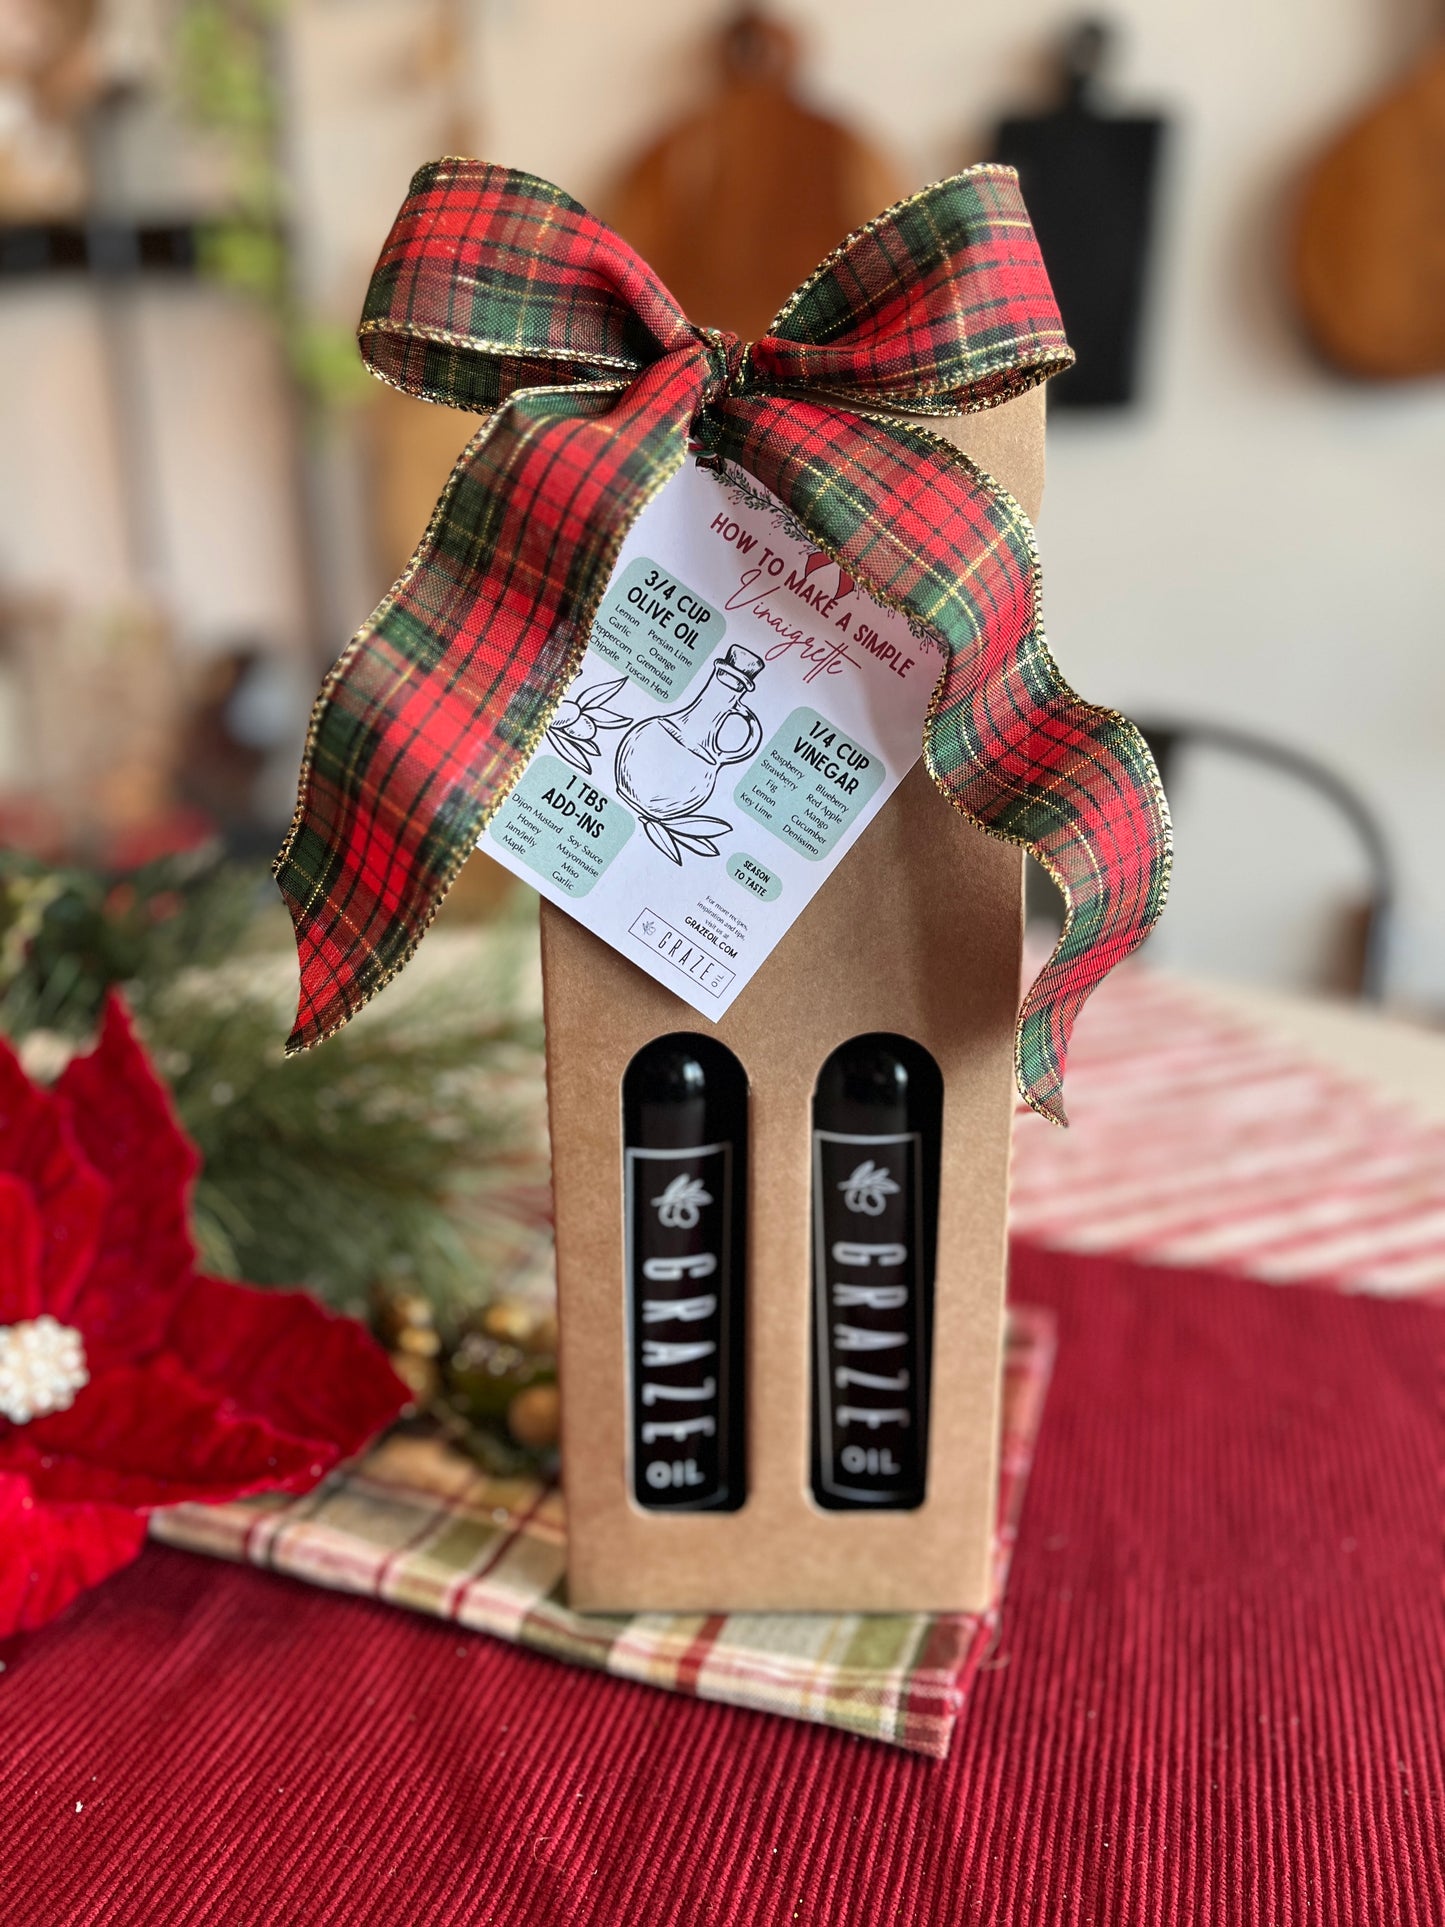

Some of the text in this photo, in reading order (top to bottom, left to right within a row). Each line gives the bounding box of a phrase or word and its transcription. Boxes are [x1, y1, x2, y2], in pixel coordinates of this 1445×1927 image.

[645, 571, 710, 624] 3/4 CUP
[710, 513, 915, 678] HOW TO MAKE A SIMPLE
[609, 616, 631, 637] Garlic
[615, 604, 640, 627] Lemon
[628, 587, 698, 650] OLIVE OIL
[725, 569, 861, 683] Vinaigrette
[590, 635, 619, 661] Chipotle
[648, 629, 692, 667] Persian Lime
[649, 647, 676, 671] Orange
[625, 662, 668, 699] Tuscan Herb
[636, 654, 673, 686] Gremolata
[809, 721, 869, 771] 1/4 CUP
[761, 760, 798, 791] Strawberry
[771, 750, 805, 780] Raspberry
[793, 736, 858, 795] VINEGAR
[566, 775, 608, 812] 1 TBS
[752, 785, 776, 806] Lemon
[766, 779, 778, 793] Fig
[816, 784, 849, 814] Blueberry
[512, 794, 564, 834] Dijon Mustard
[541, 788, 605, 838] ADD-INS
[740, 792, 772, 820] Key Lime
[804, 809, 828, 830] Mango
[806, 794, 842, 824] Red Apple
[517, 813, 542, 835] Honey
[791, 815, 827, 844] Cucumber
[502, 835, 526, 855] Maple
[568, 835, 603, 864] Soy Sauce
[782, 825, 819, 855] Denissimo
[556, 844, 599, 878] Mayonnaise
[561, 862, 579, 878] Miso
[743, 861, 770, 884] SEASON
[552, 871, 574, 890] Garlic
[734, 869, 767, 897] TO TASTE
[697, 902, 724, 925] inspiration
[724, 921, 735, 932] and
[706, 896, 715, 905] For
[715, 903, 729, 915] more
[684, 916, 738, 959] GRAZEOIL.COM
[705, 920, 716, 930] visit
[716, 927, 723, 935] us
[658, 931, 724, 988] GRAZE OIL
[642, 1253, 717, 1443] GRAZE
[832, 1241, 910, 1428] GRAZE
[645, 1458, 705, 1489] OIL
[841, 1445, 901, 1476] OIL
